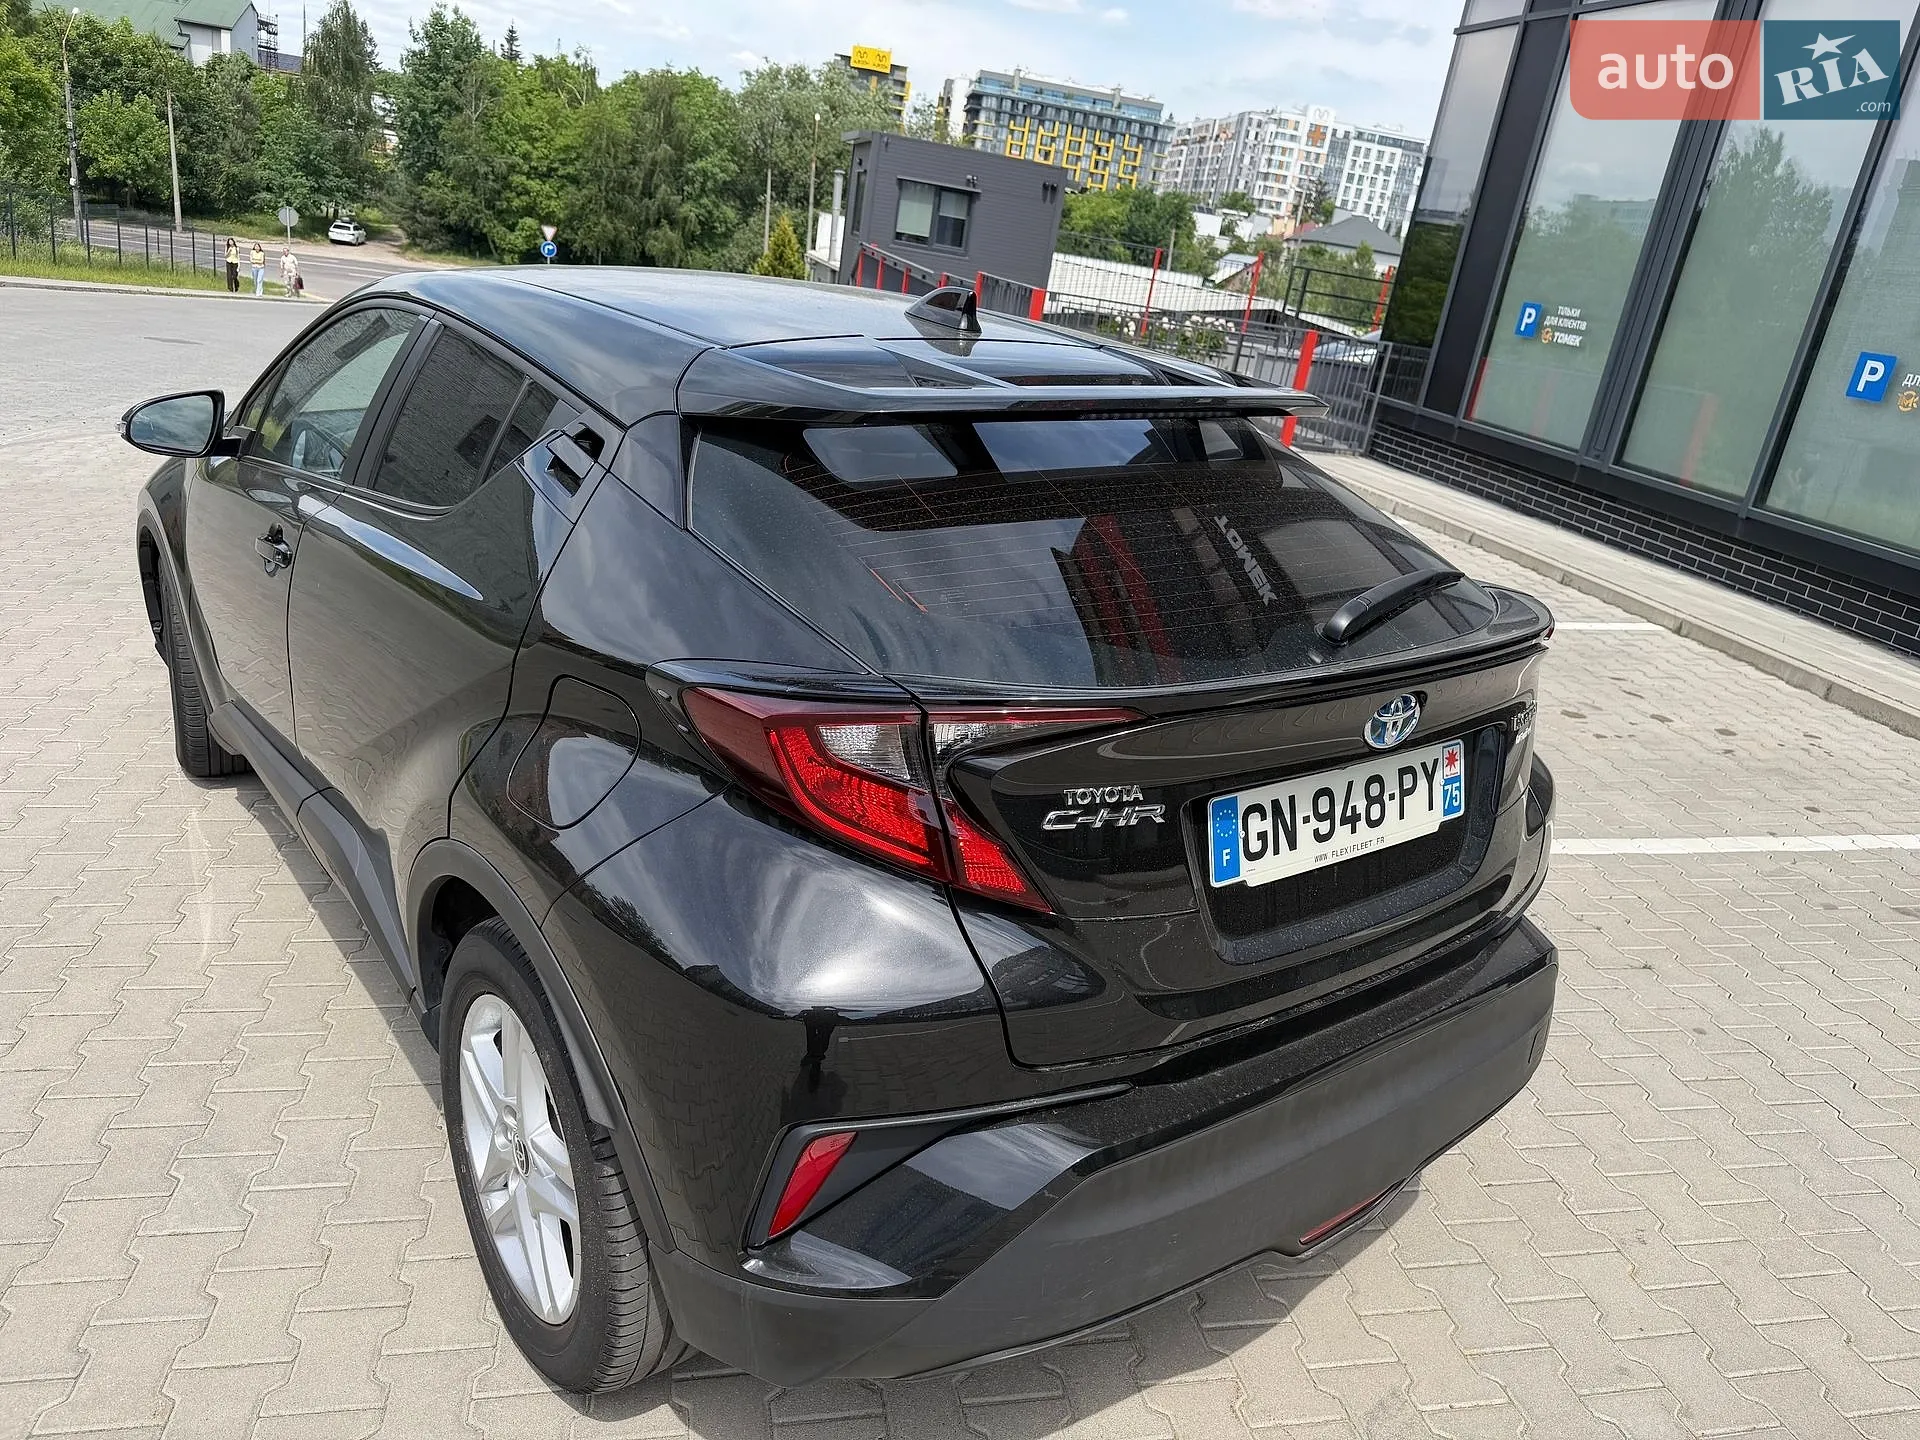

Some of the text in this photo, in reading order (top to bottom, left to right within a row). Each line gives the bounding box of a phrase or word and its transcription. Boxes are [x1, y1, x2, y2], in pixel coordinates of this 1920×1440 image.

[1520, 307, 1536, 332] P
[1857, 359, 1885, 392] P
[1063, 785, 1144, 805] TOYOTA
[1042, 804, 1166, 831] C-HR
[1223, 757, 1461, 867] F GN-948-PY 75
